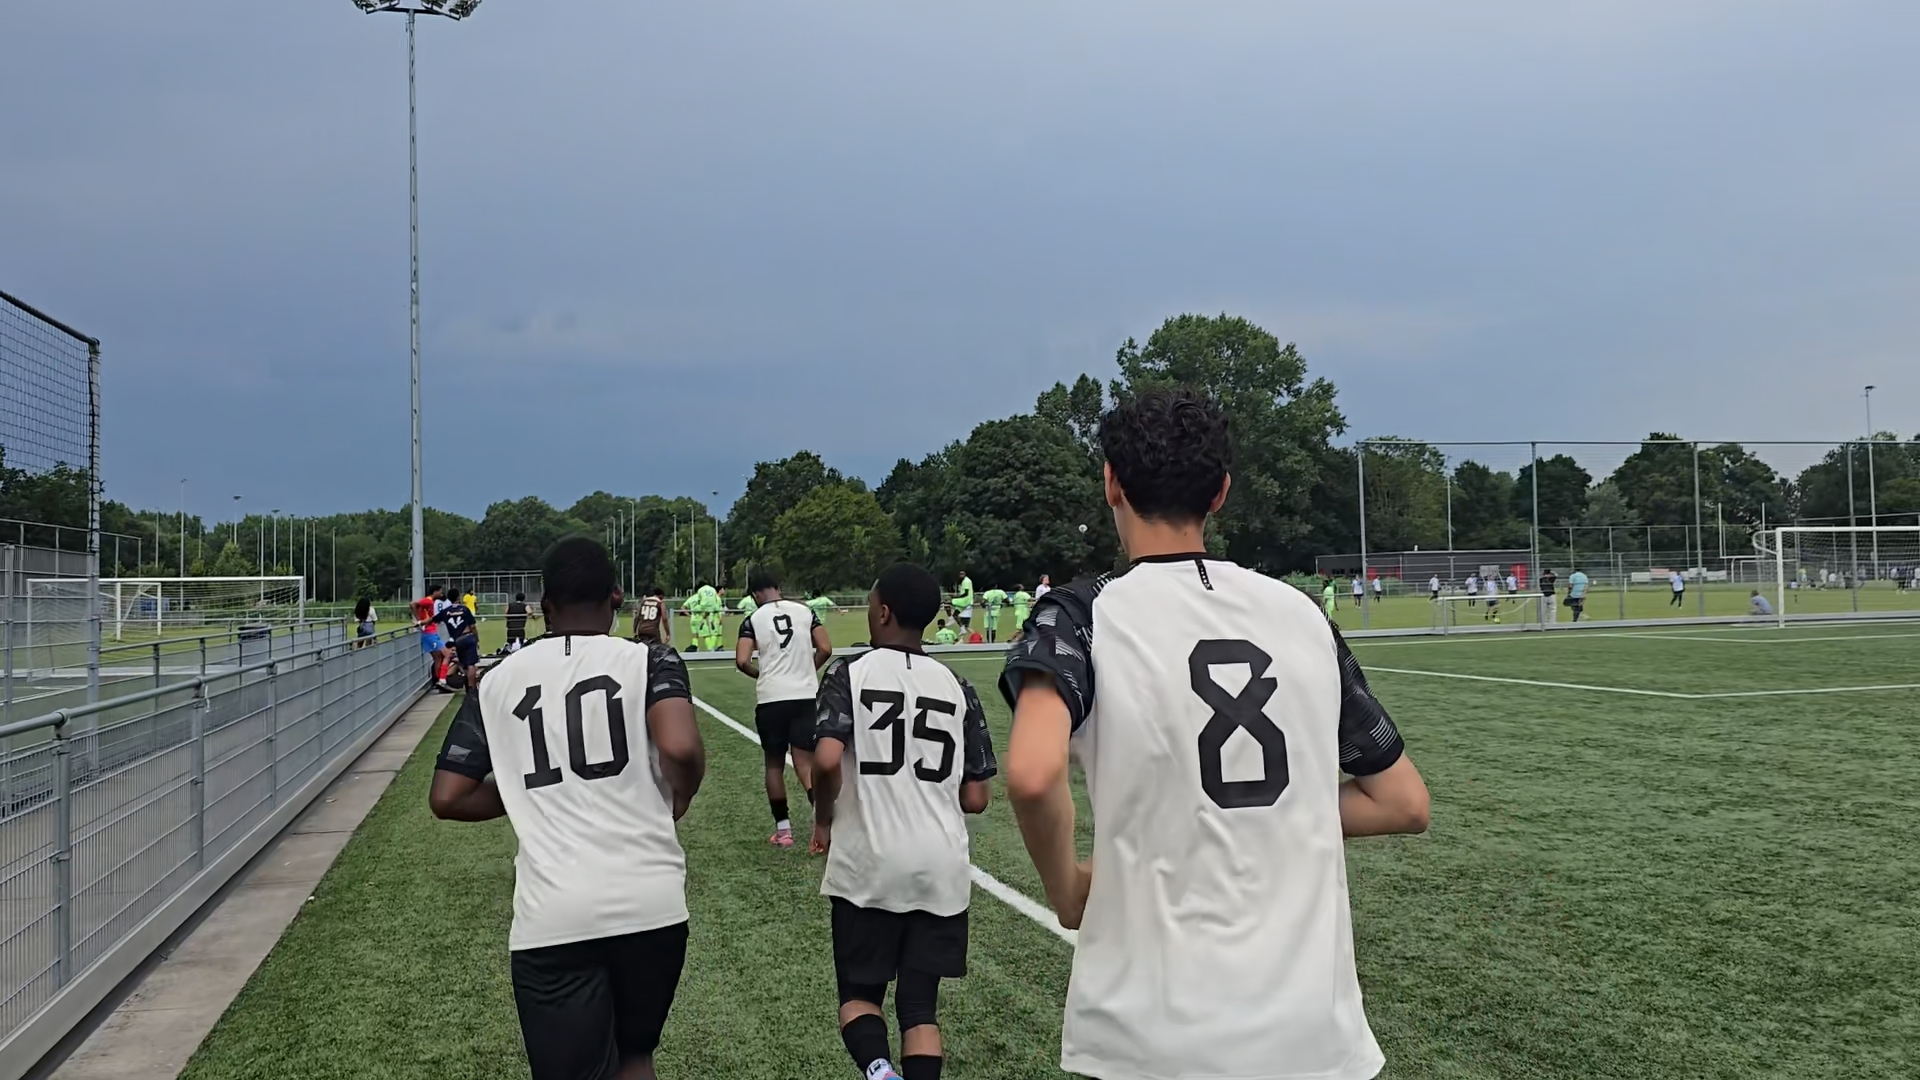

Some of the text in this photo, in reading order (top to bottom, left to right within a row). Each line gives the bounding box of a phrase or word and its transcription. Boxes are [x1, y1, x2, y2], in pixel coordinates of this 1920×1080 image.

[641, 605, 658, 620] 48
[773, 614, 793, 649] 9
[512, 674, 629, 790] 10
[859, 689, 957, 783] 35
[1188, 639, 1289, 809] 8
